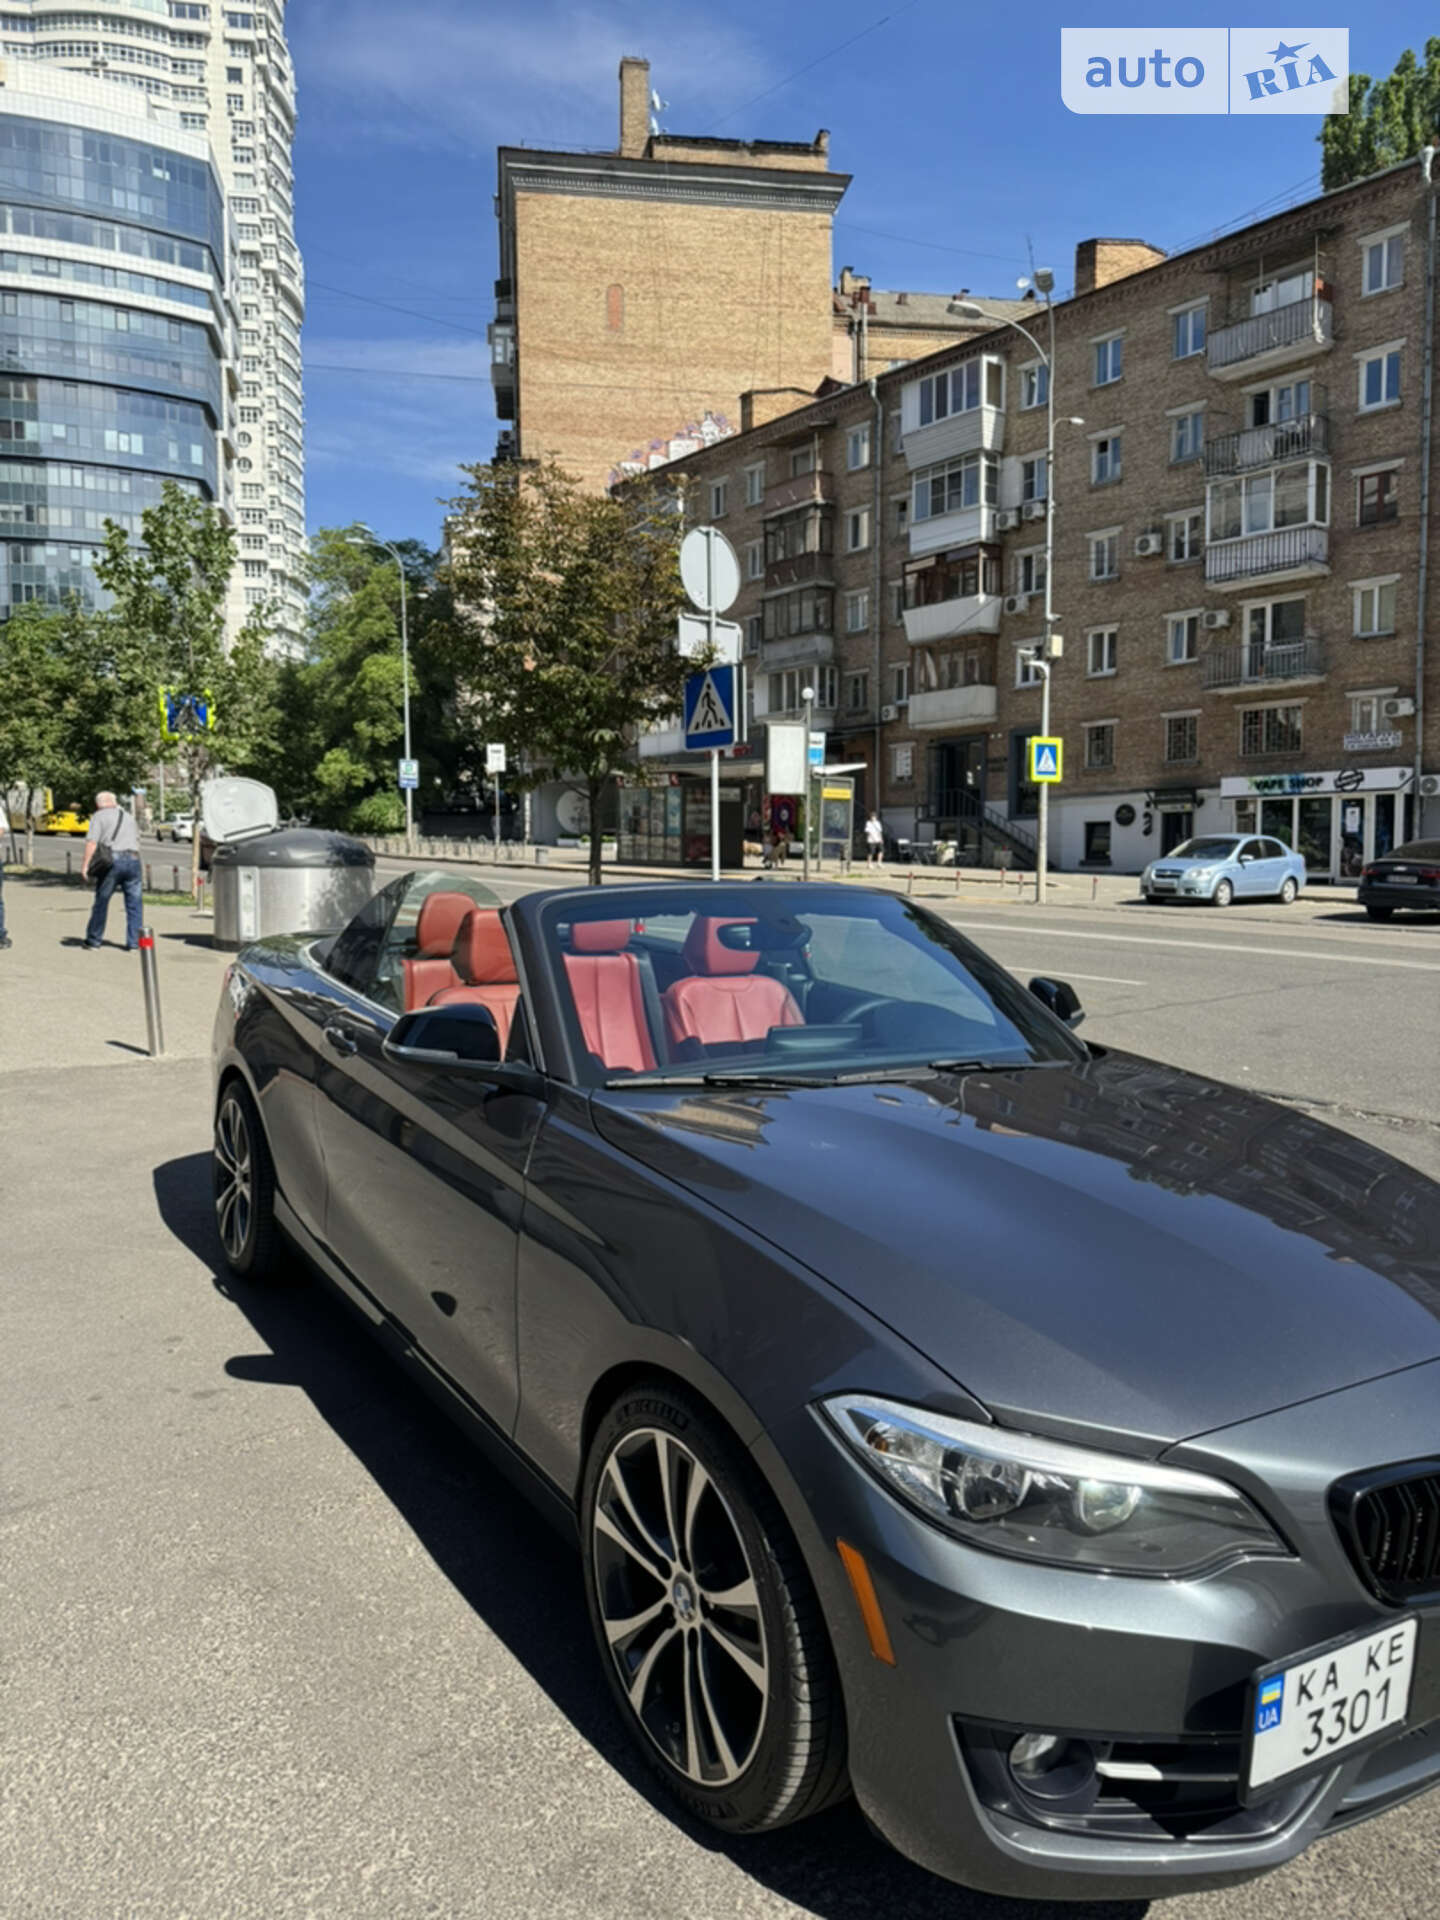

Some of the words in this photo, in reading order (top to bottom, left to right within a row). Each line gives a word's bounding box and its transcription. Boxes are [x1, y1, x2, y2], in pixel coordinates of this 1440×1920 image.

[1254, 778, 1284, 790] VAPE
[1290, 776, 1324, 788] SHOP
[1297, 1662, 1338, 1706] KA
[1366, 1632, 1405, 1676] KE
[1258, 1707, 1279, 1730] UA
[1303, 1678, 1391, 1756] 3301
